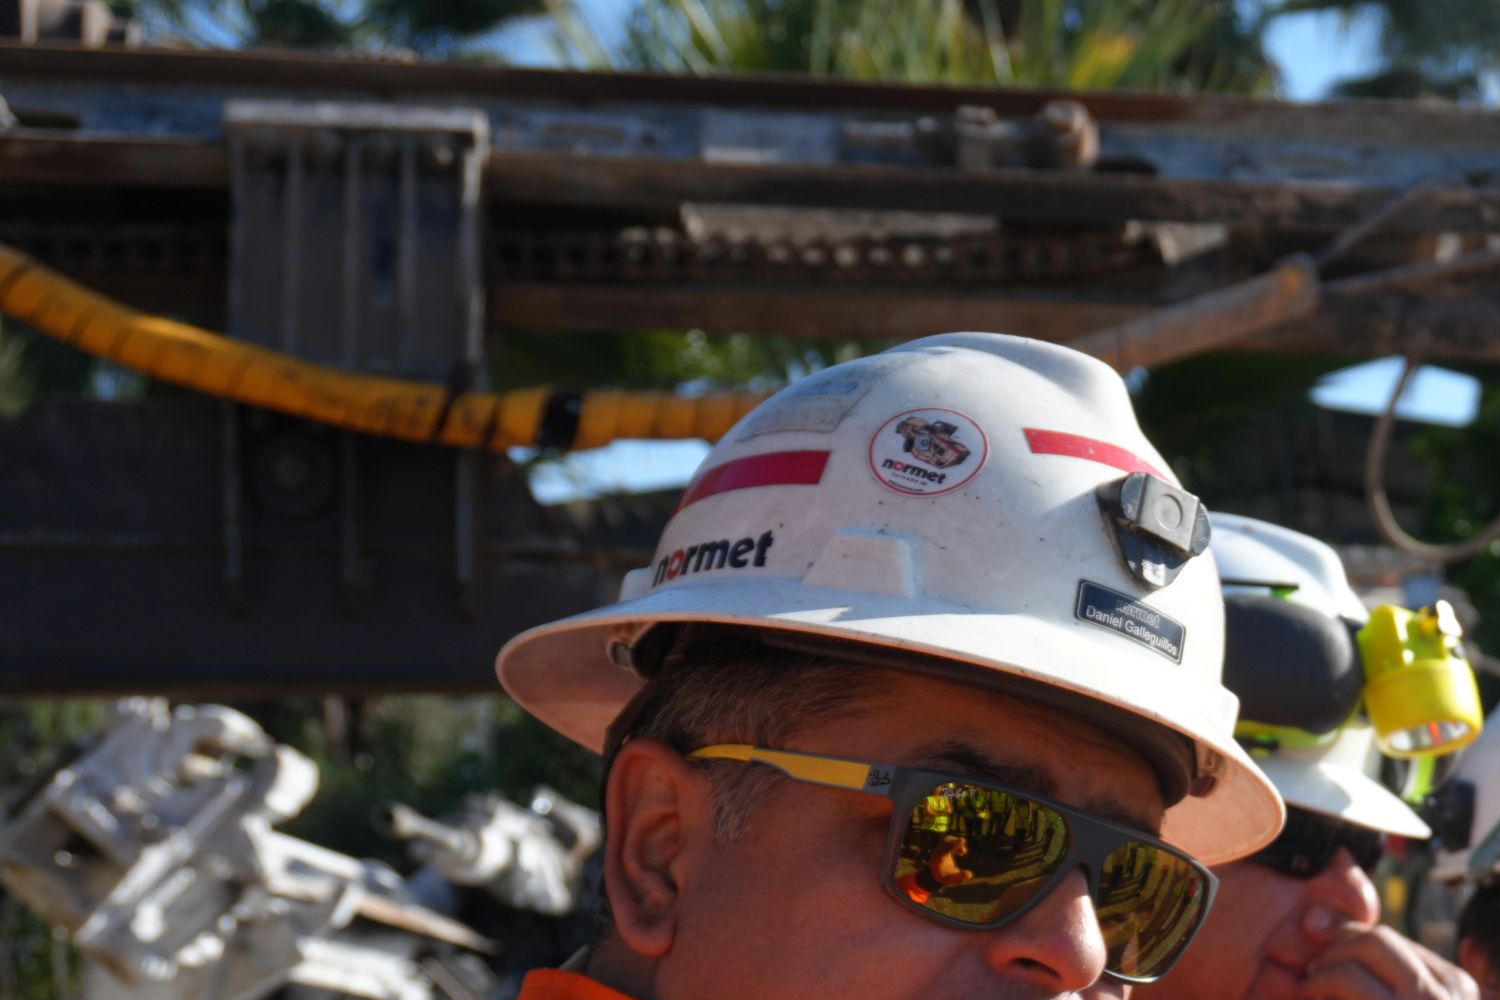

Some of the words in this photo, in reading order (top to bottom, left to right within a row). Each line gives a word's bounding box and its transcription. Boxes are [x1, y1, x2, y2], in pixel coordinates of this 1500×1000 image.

[883, 459, 946, 485] normet
[652, 530, 774, 587] normet
[1086, 605, 1123, 628] Daniel
[1124, 619, 1177, 655] Galleguillos
